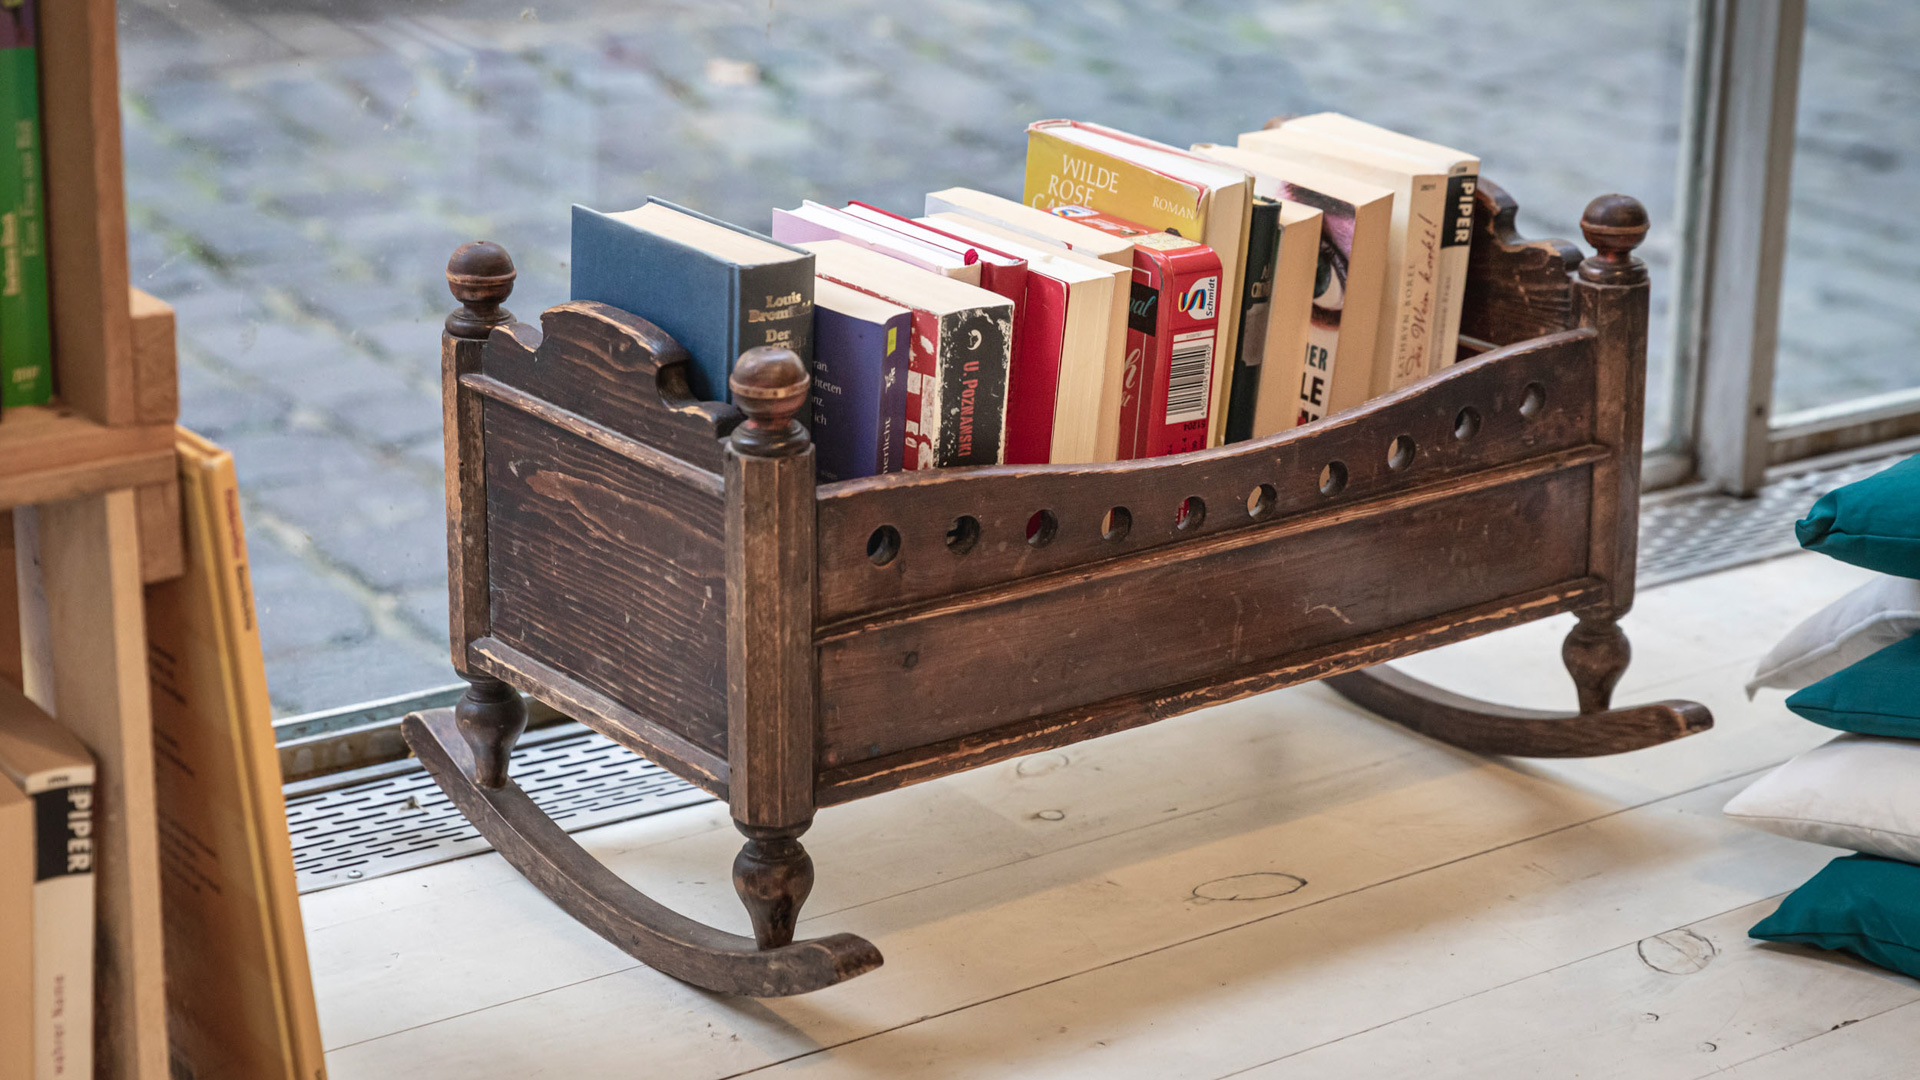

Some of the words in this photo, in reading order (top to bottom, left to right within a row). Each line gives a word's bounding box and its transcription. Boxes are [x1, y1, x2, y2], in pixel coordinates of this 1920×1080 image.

[1048, 174, 1095, 209] ROSE
[1063, 154, 1120, 194] WILDE
[1152, 196, 1195, 221] ROMAN
[1454, 181, 1476, 243] PIPER
[765, 291, 802, 308] Louis
[1206, 278, 1216, 317] Schmidt
[1411, 291, 1430, 340] Wein
[765, 329, 791, 343] Der
[963, 360, 980, 378] U.
[1304, 342, 1328, 372] ER
[957, 379, 979, 457] POZNANSKI
[67, 791, 92, 873] PIPER
